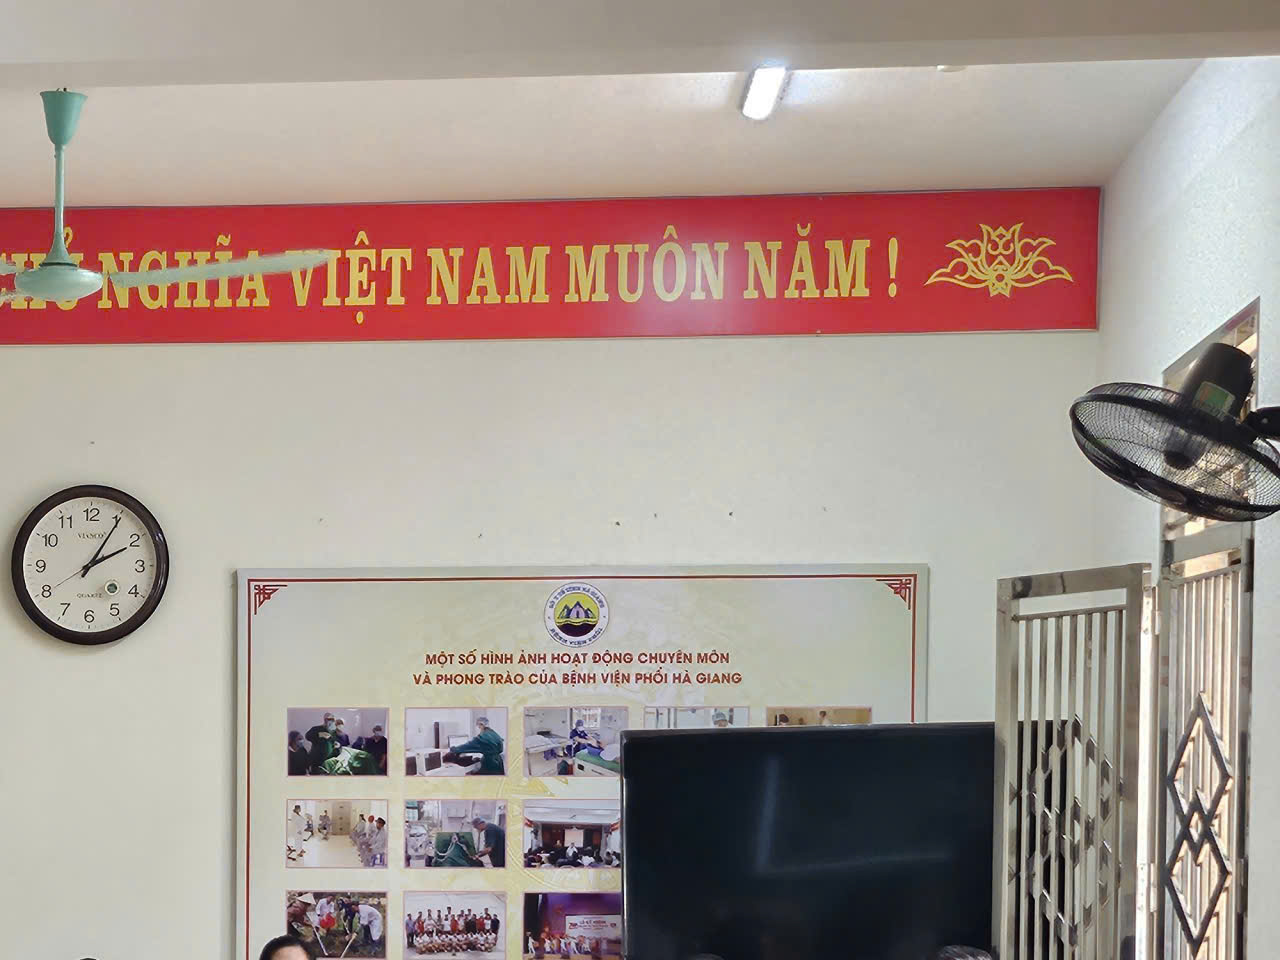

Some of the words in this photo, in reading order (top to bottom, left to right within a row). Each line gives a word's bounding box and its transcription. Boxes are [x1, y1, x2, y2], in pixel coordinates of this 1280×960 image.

[97, 234, 270, 309] NGHĨA
[285, 231, 412, 325] VIỆT
[427, 246, 551, 305] NAM
[564, 225, 729, 303] MUÔN
[743, 223, 870, 299] NĂM
[58, 515, 73, 528] 11
[83, 508, 100, 522] 12
[42, 534, 58, 547] 10
[130, 534, 140, 547] 2
[35, 560, 46, 573] 9
[135, 560, 145, 573] 3
[41, 585, 52, 598] 8
[128, 584, 140, 598] 4
[60, 603, 70, 616] 7
[109, 603, 120, 617] 5
[84, 610, 95, 623] 6
[425, 651, 455, 668] MỘT
[458, 649, 476, 665] SỐ
[480, 650, 513, 665] HÌNH
[551, 653, 589, 667] HOẠT
[592, 650, 634, 666] ĐỘNG
[637, 650, 693, 664] CHUYÊN
[696, 650, 730, 664] MÔN
[412, 671, 432, 685] VÀ
[436, 673, 485, 685] PHONG
[488, 670, 524, 685] TRÀO
[528, 669, 558, 684] CỦA
[562, 670, 597, 687] BỆNH
[601, 670, 631, 687] VIỆN
[634, 666, 668, 684] PHỔI
[672, 670, 692, 684] HÀ
[695, 672, 742, 684] GIANG
